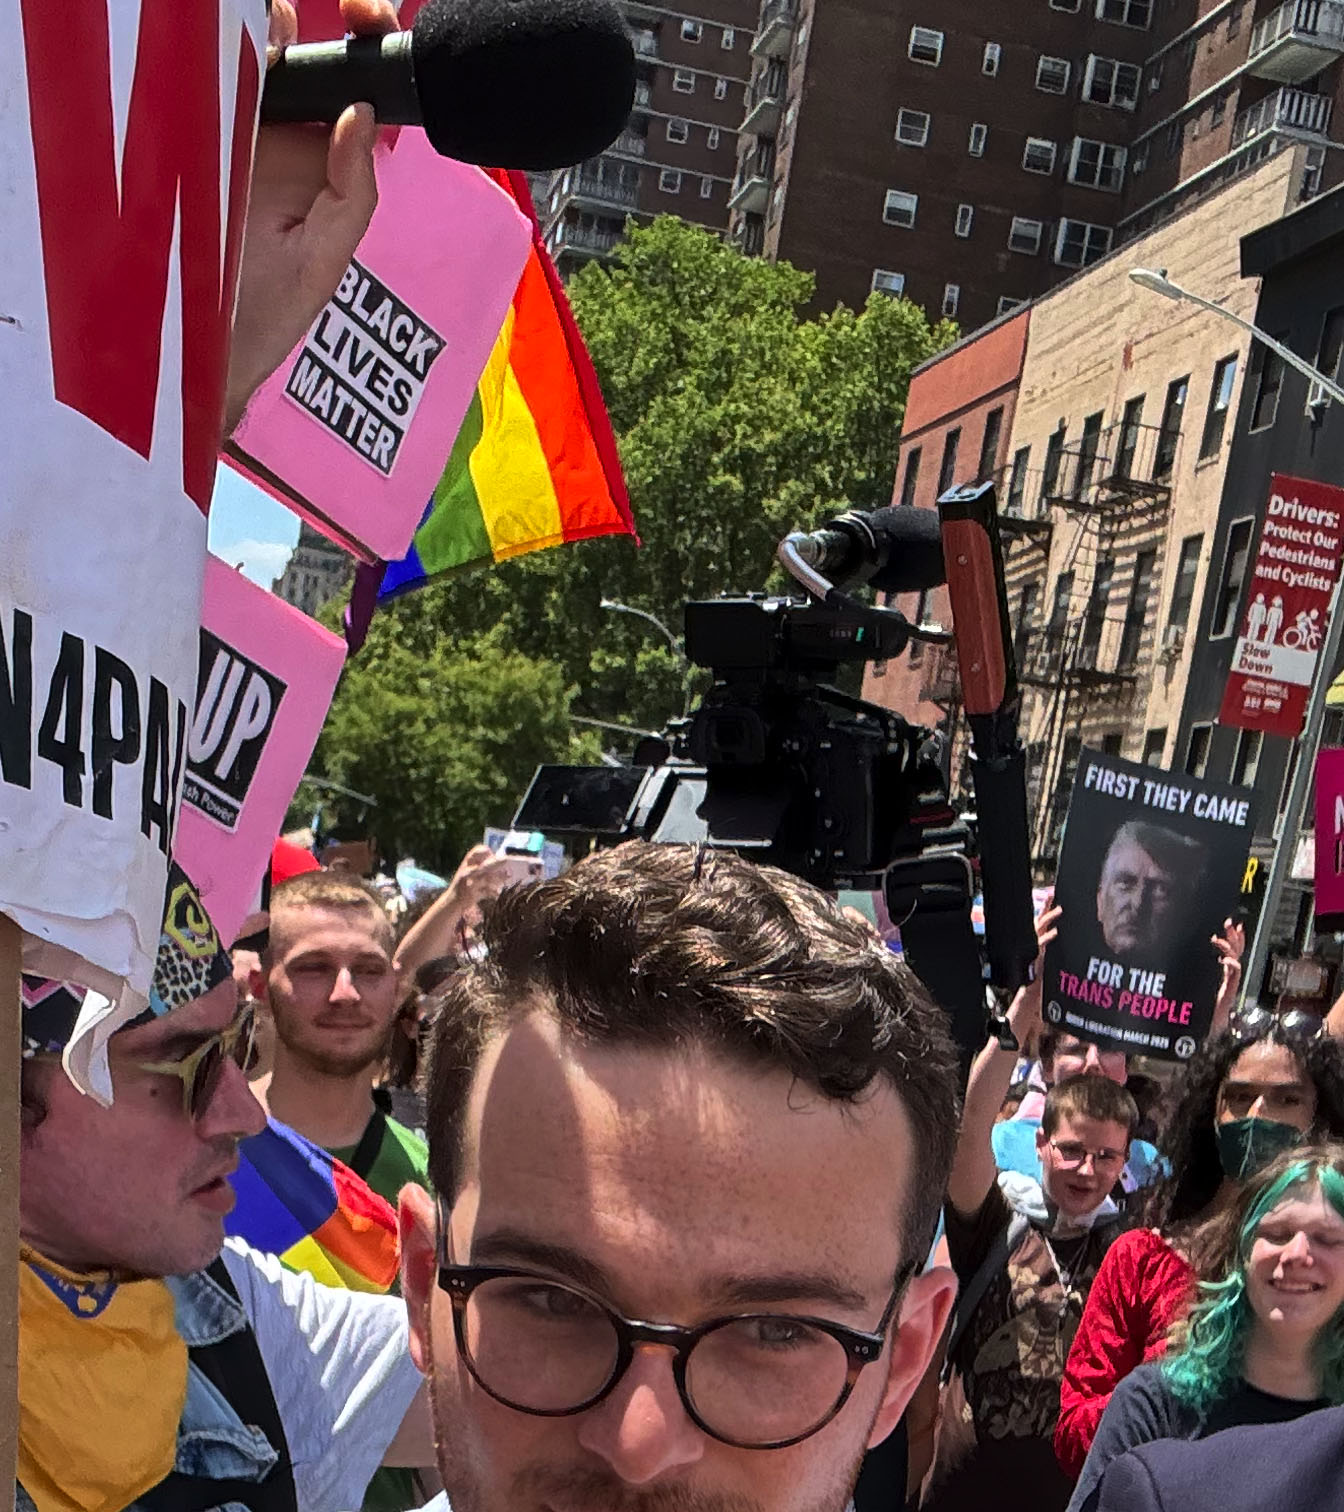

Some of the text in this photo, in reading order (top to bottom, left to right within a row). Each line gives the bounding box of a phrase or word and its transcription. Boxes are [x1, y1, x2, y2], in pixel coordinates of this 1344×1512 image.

[335, 263, 438, 375] BLACK
[314, 308, 413, 416] LIVES
[290, 356, 396, 469] MATTER
[1268, 493, 1340, 529] Drivers:
[1259, 541, 1336, 571] Pedestrians
[1262, 520, 1339, 550] Protect Our
[1255, 563, 1331, 593] and Cyclists
[1239, 655, 1273, 674] Down
[1242, 642, 1271, 659] Slow
[188, 648, 272, 781] UP
[1084, 762, 1250, 826] FIRST THEY CAME
[1058, 970, 1194, 1026] TRANS PEOPLE
[1086, 956, 1166, 998] FOR THE
